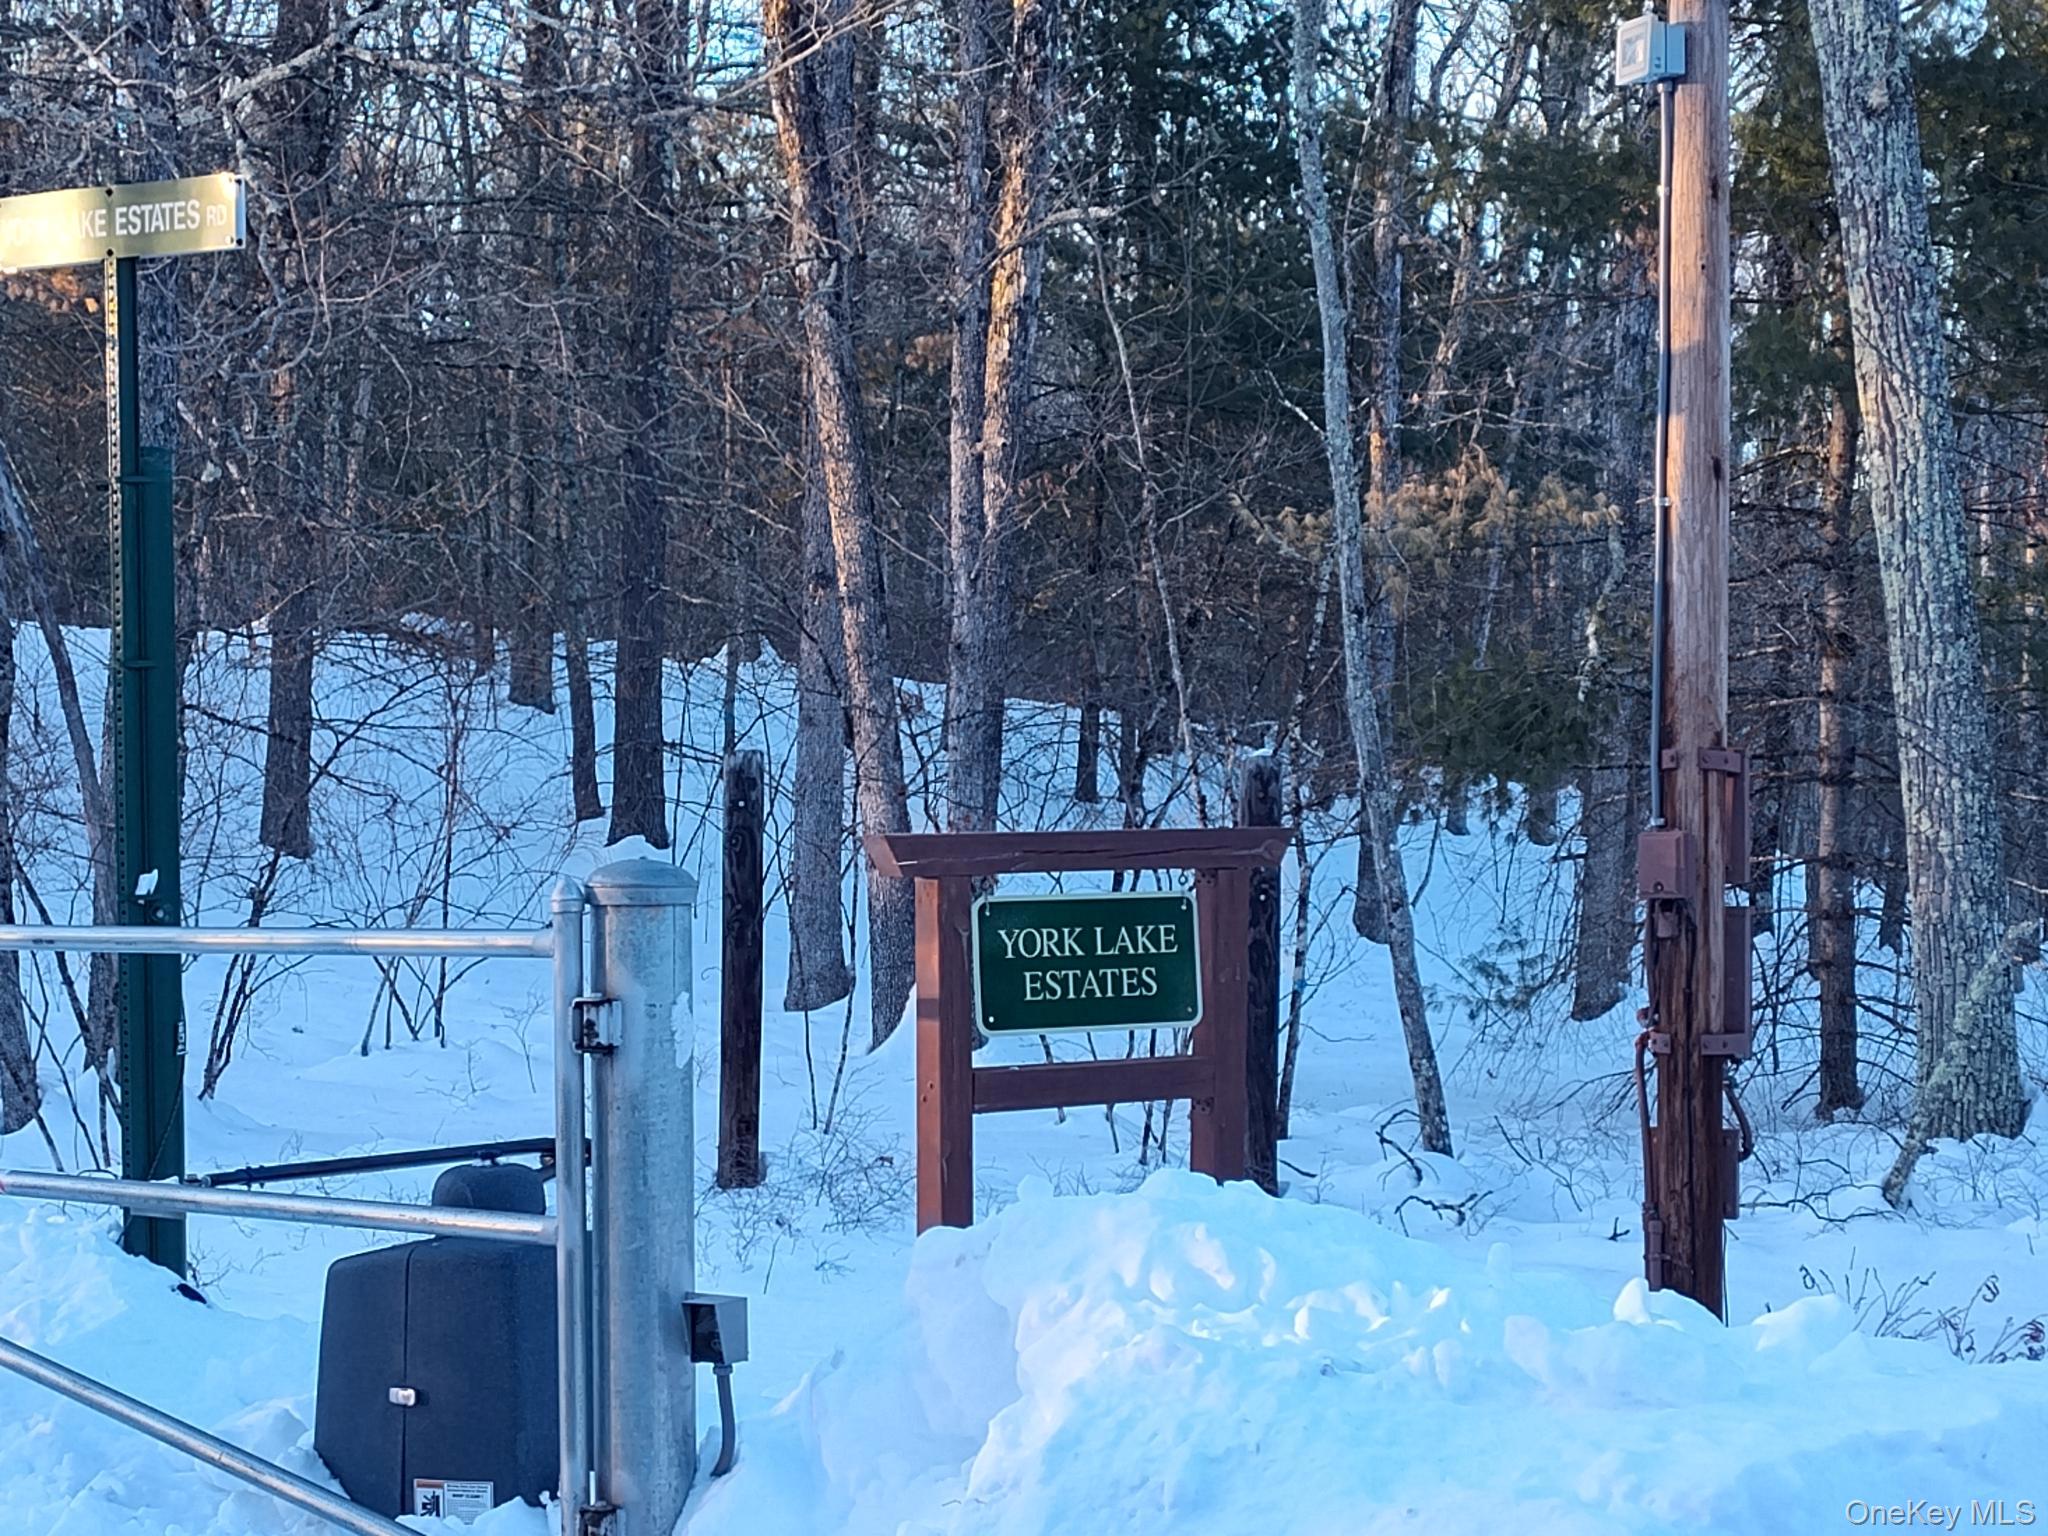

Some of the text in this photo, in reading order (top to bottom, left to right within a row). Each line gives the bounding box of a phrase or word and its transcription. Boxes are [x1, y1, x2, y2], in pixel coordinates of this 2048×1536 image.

[115, 199, 200, 236] ESTATES
[206, 205, 227, 227] RD
[998, 924, 1179, 959] YORK LAKE
[1024, 967, 1158, 1001] ESTATES
